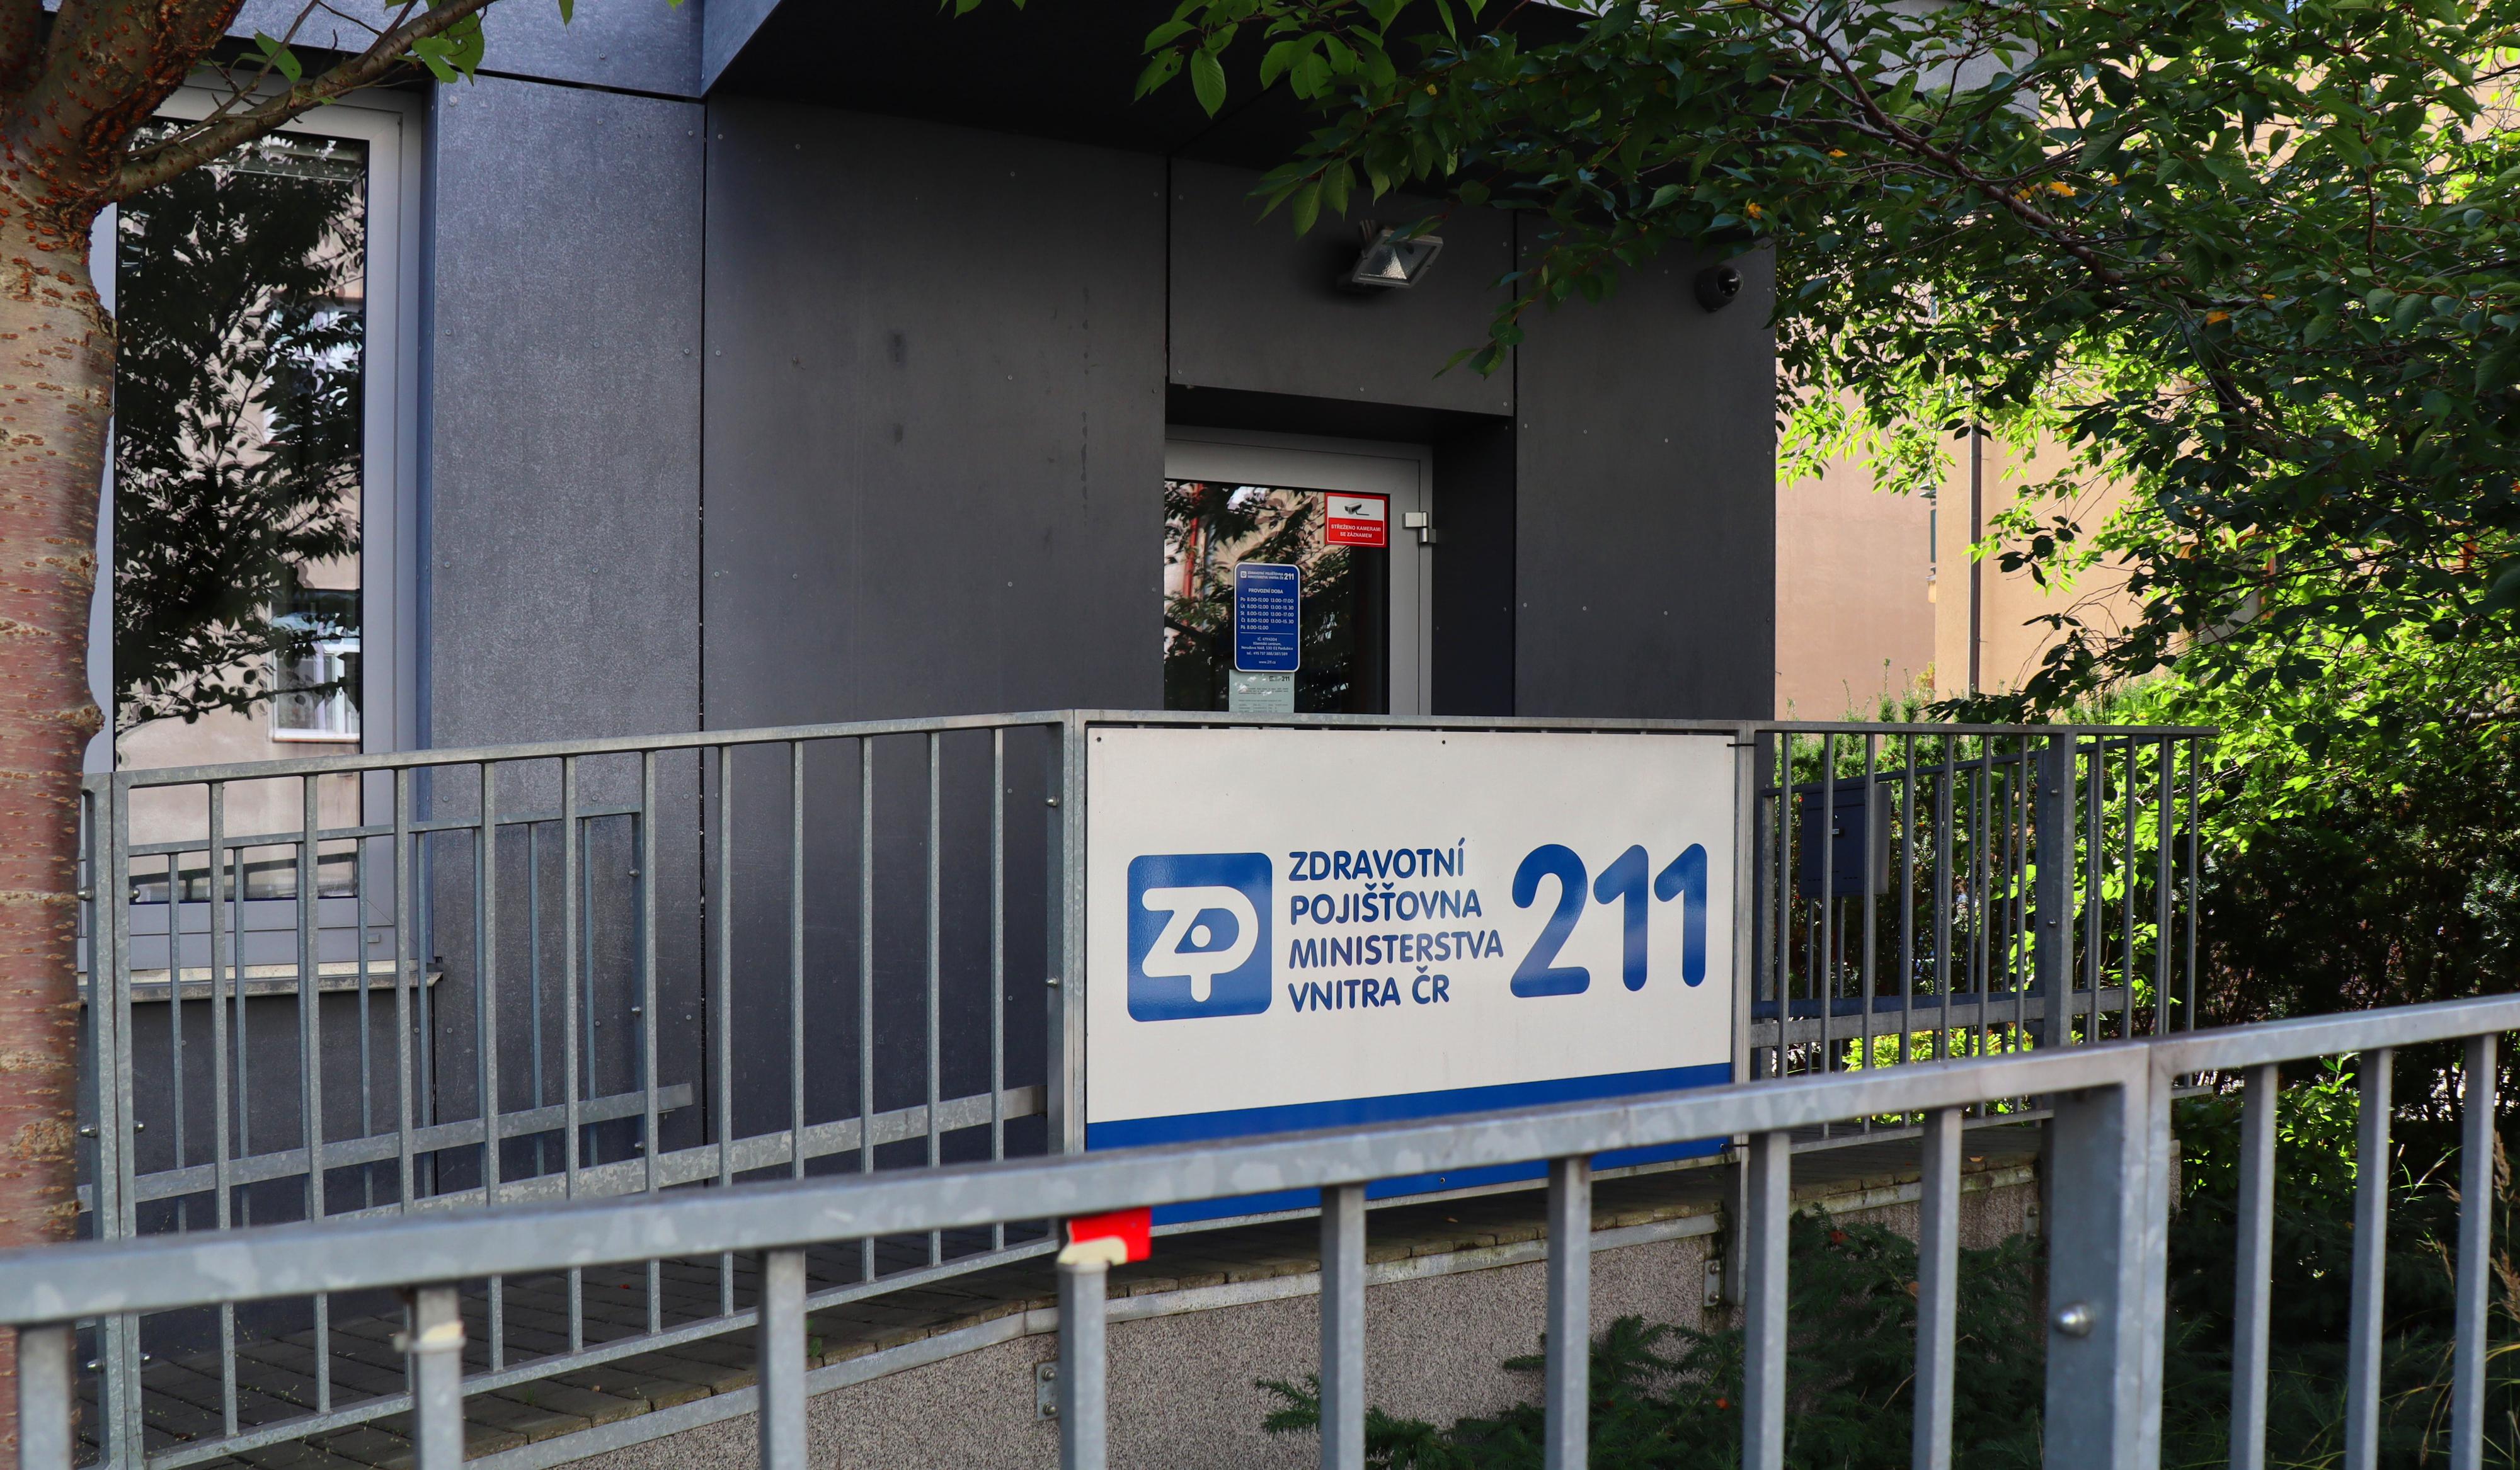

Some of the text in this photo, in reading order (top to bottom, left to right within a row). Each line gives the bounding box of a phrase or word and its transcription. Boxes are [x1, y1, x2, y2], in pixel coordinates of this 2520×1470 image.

[1289, 838, 1465, 881] ZDRAVOTNÍ
[1290, 882, 1482, 925] POJIŠŤOVNA
[1511, 843, 1709, 998] 211
[1289, 930, 1504, 969] MINISTERSTVA
[1288, 966, 1450, 1013] VNITRA ČR
